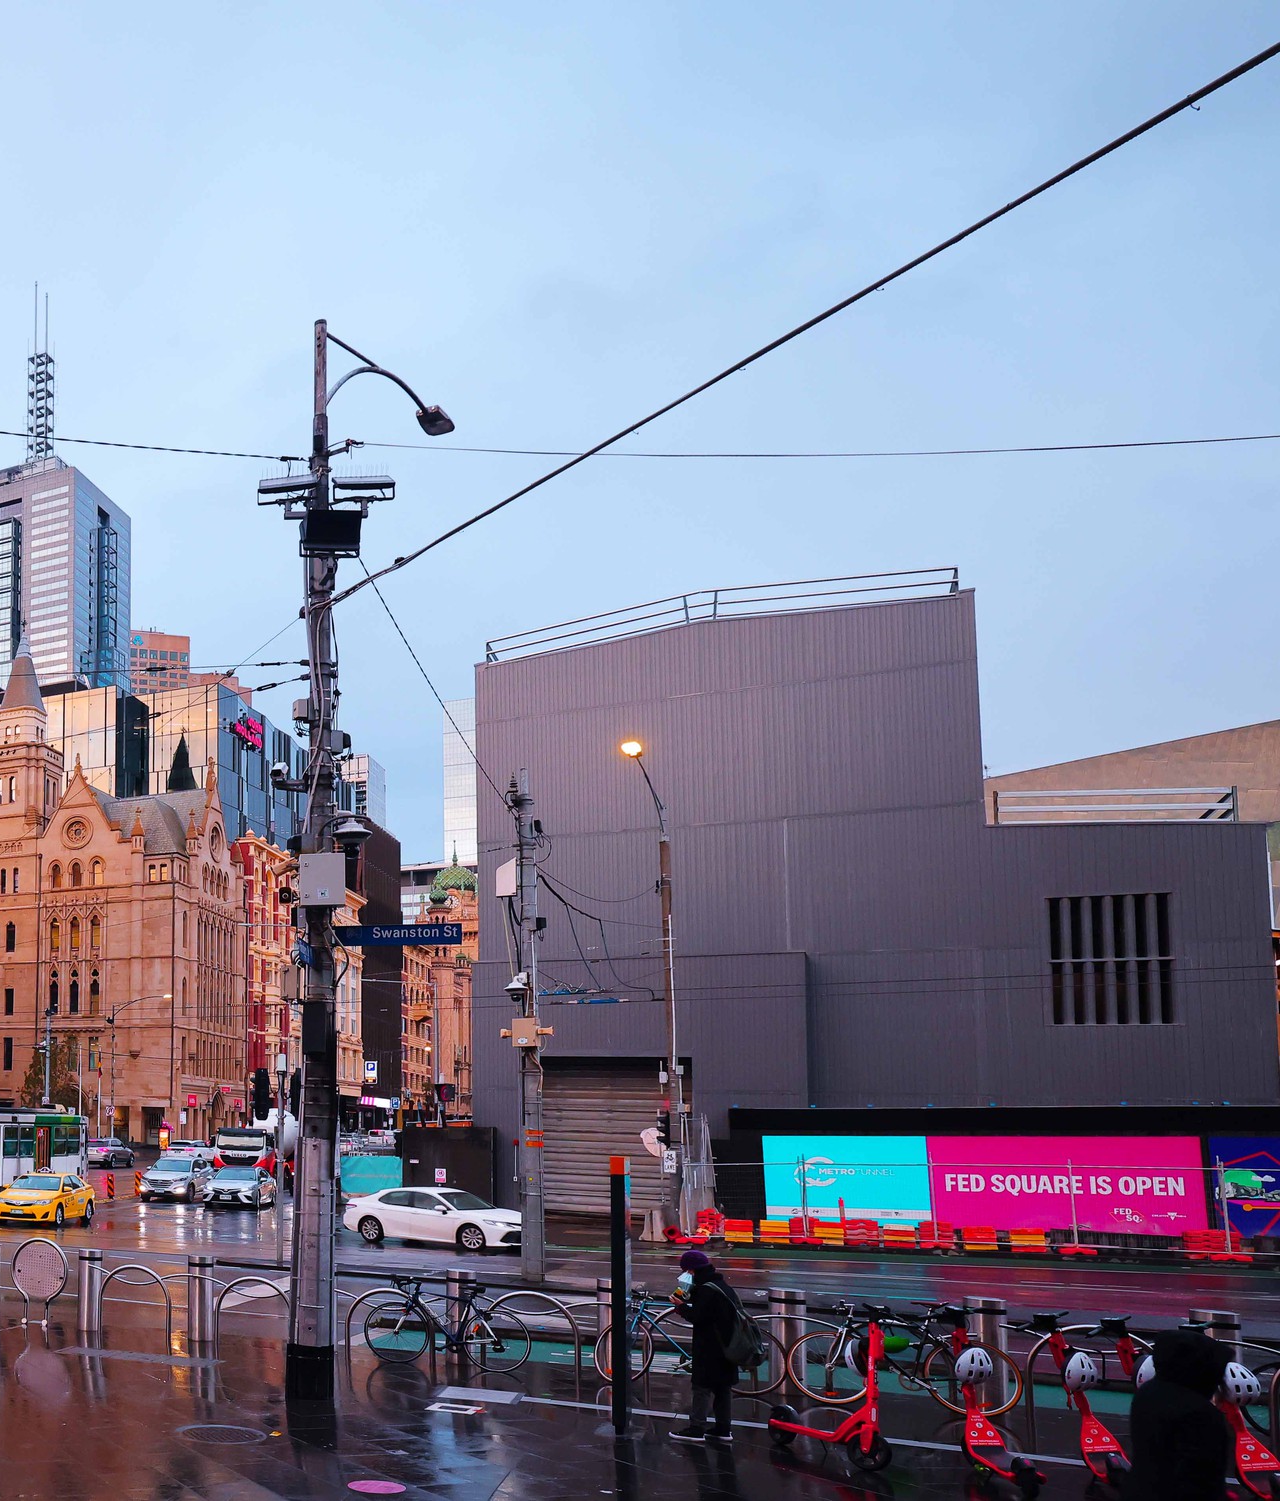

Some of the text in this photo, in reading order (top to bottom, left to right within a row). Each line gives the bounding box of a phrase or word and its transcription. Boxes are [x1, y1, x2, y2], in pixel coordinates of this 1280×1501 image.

[372, 925, 458, 939] Swanston St
[856, 1168, 895, 1176] TUNNEL
[944, 1173, 1185, 1196] FED SQUARE IS OPEN
[1113, 1207, 1132, 1215] FED
[1125, 1214, 1143, 1223] SQ.
